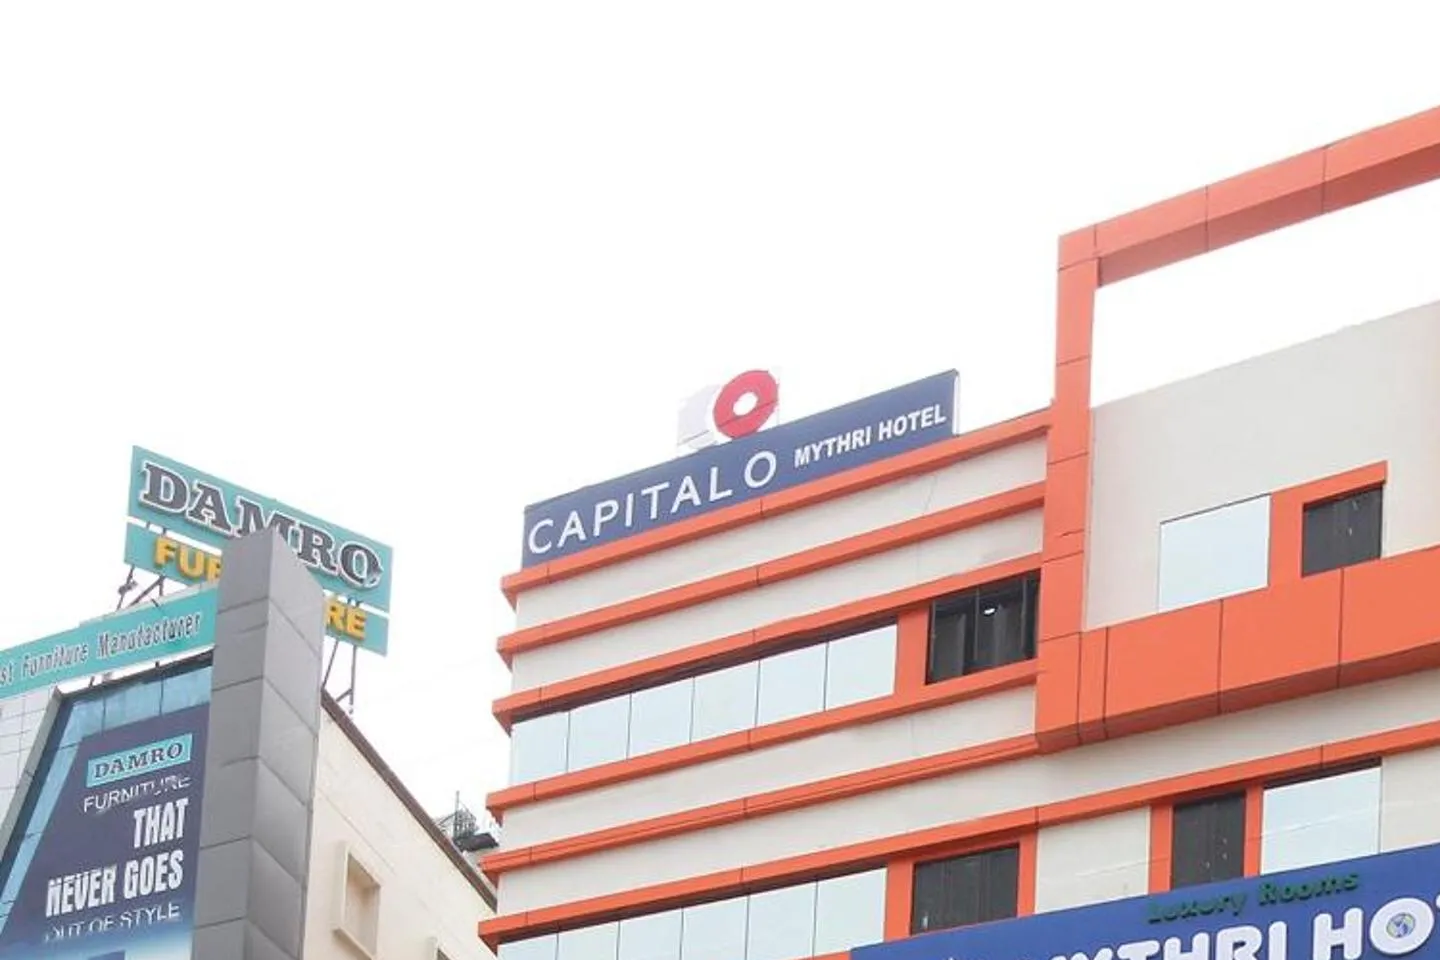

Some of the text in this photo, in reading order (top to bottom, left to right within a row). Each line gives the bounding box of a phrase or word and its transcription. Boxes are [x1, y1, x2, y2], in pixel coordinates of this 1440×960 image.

[528, 403, 946, 555] CAPITAL O MYTHRI HOTEL
[140, 460, 384, 589] DAMRO
[97, 611, 201, 660] Manufacturer
[94, 742, 183, 778] DAMRO
[83, 774, 192, 813] FURNITURE
[134, 797, 189, 848] THAT
[46, 850, 184, 918] NEVER GOES
[1259, 874, 1359, 906] Rooms
[89, 915, 114, 933] OF
[120, 902, 180, 929] STYLE
